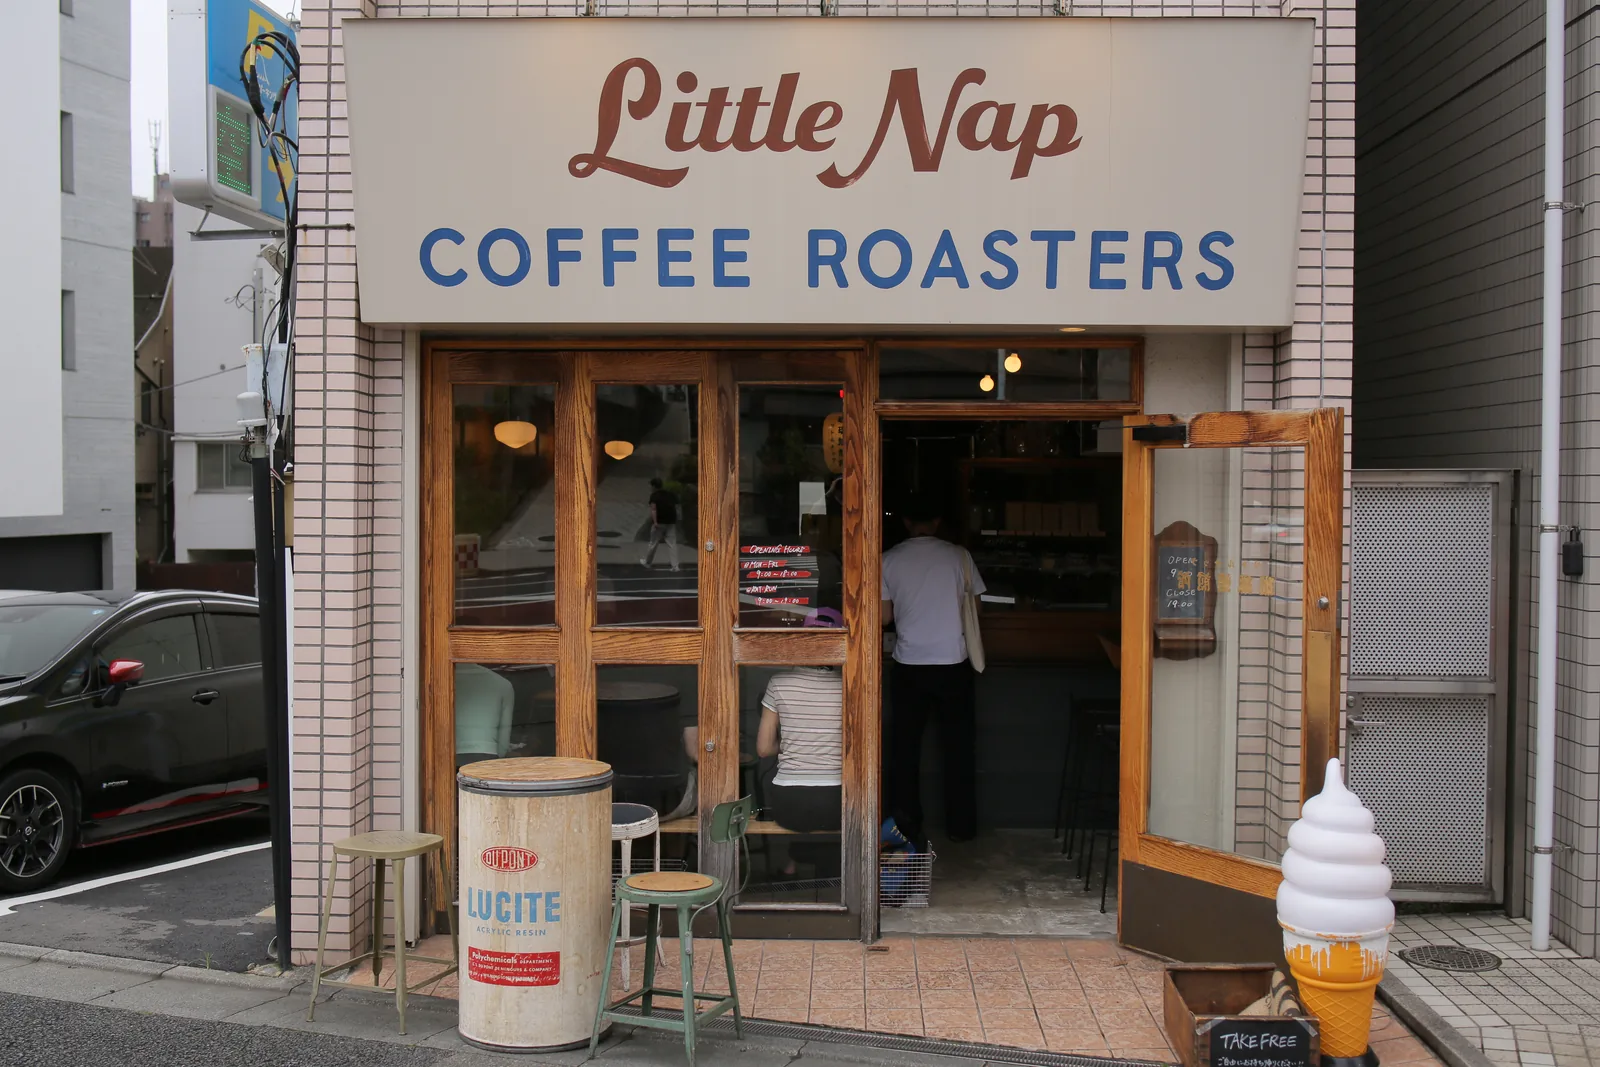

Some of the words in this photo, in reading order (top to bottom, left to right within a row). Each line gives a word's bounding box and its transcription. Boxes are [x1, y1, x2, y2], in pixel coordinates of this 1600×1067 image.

[568, 57, 843, 189] Little
[816, 67, 1084, 189] Nap
[419, 227, 751, 288] COFFEE
[807, 228, 1235, 291] ROASTERS
[750, 544, 782, 553] OPENING
[468, 887, 561, 923] LUCITE
[476, 926, 511, 936] ACRYLIC
[472, 951, 518, 964] Polychemicals
[1220, 1032, 1258, 1050] TAKE
[1260, 1033, 1297, 1050] FREE
